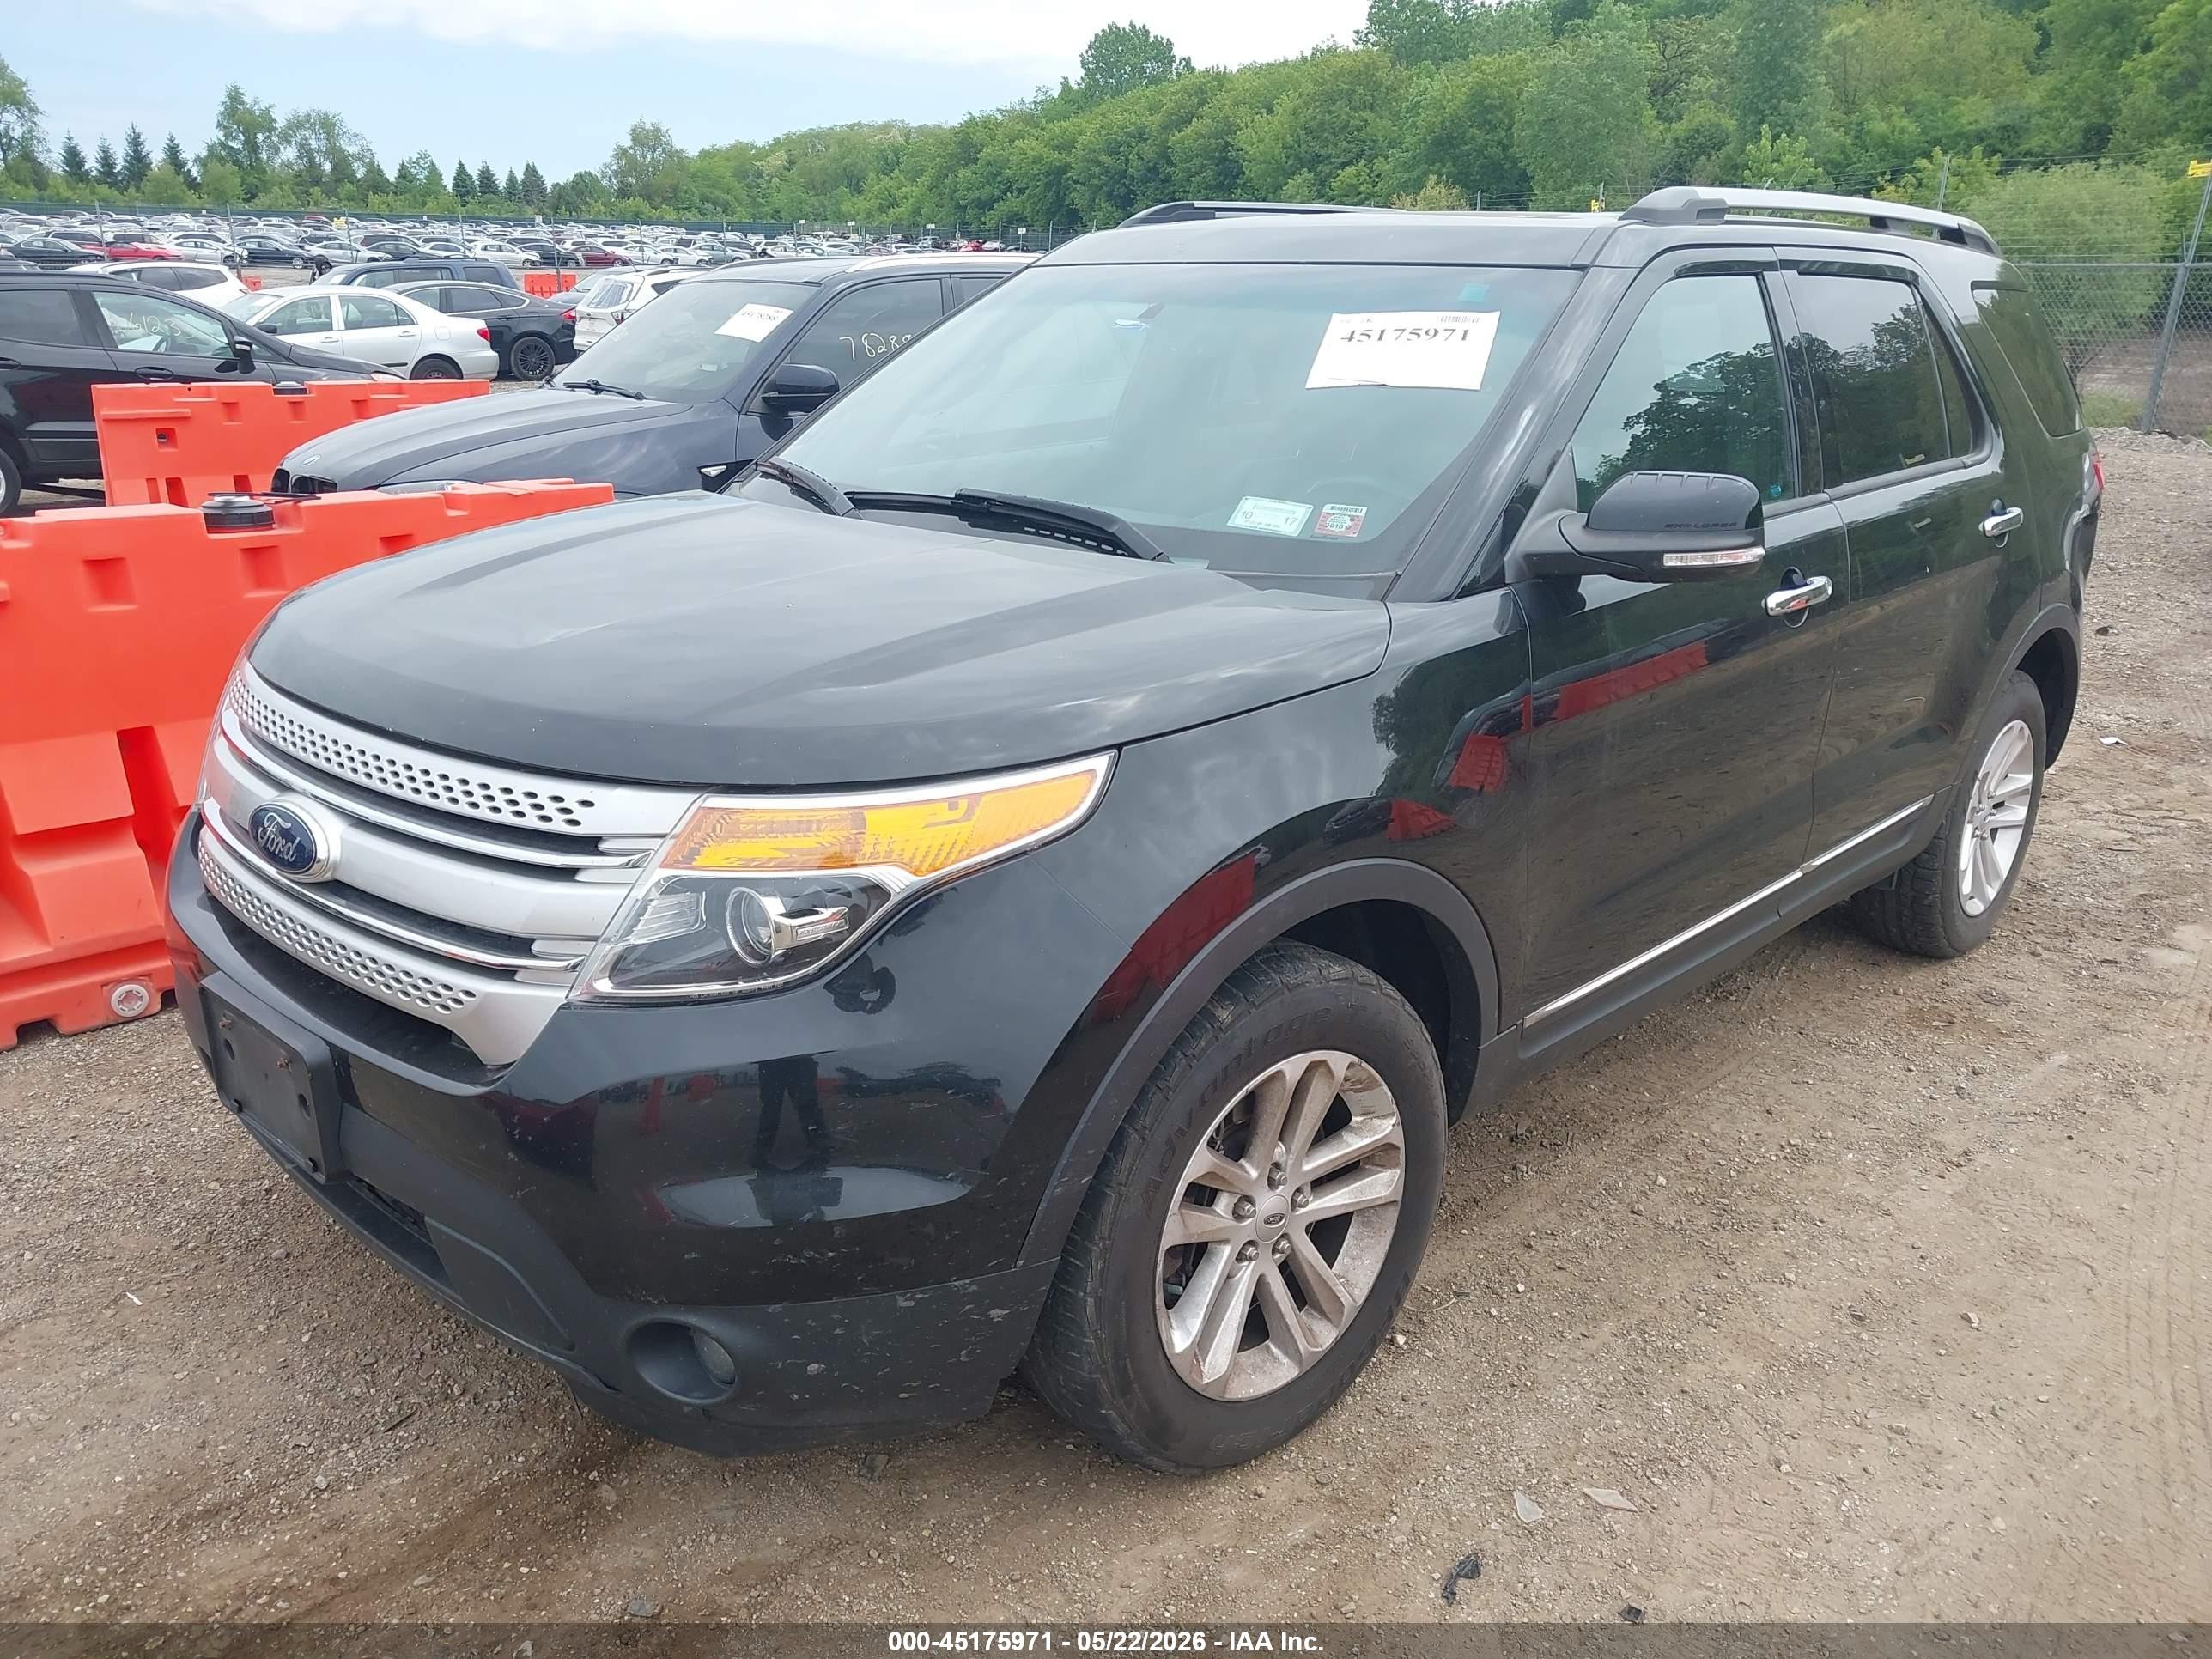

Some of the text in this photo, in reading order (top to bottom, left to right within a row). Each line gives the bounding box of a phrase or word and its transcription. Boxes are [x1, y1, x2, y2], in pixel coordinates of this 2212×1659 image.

[1340, 327, 1470, 343] 45175971
[1284, 516, 1299, 526] 17
[258, 812, 301, 862] Ford
